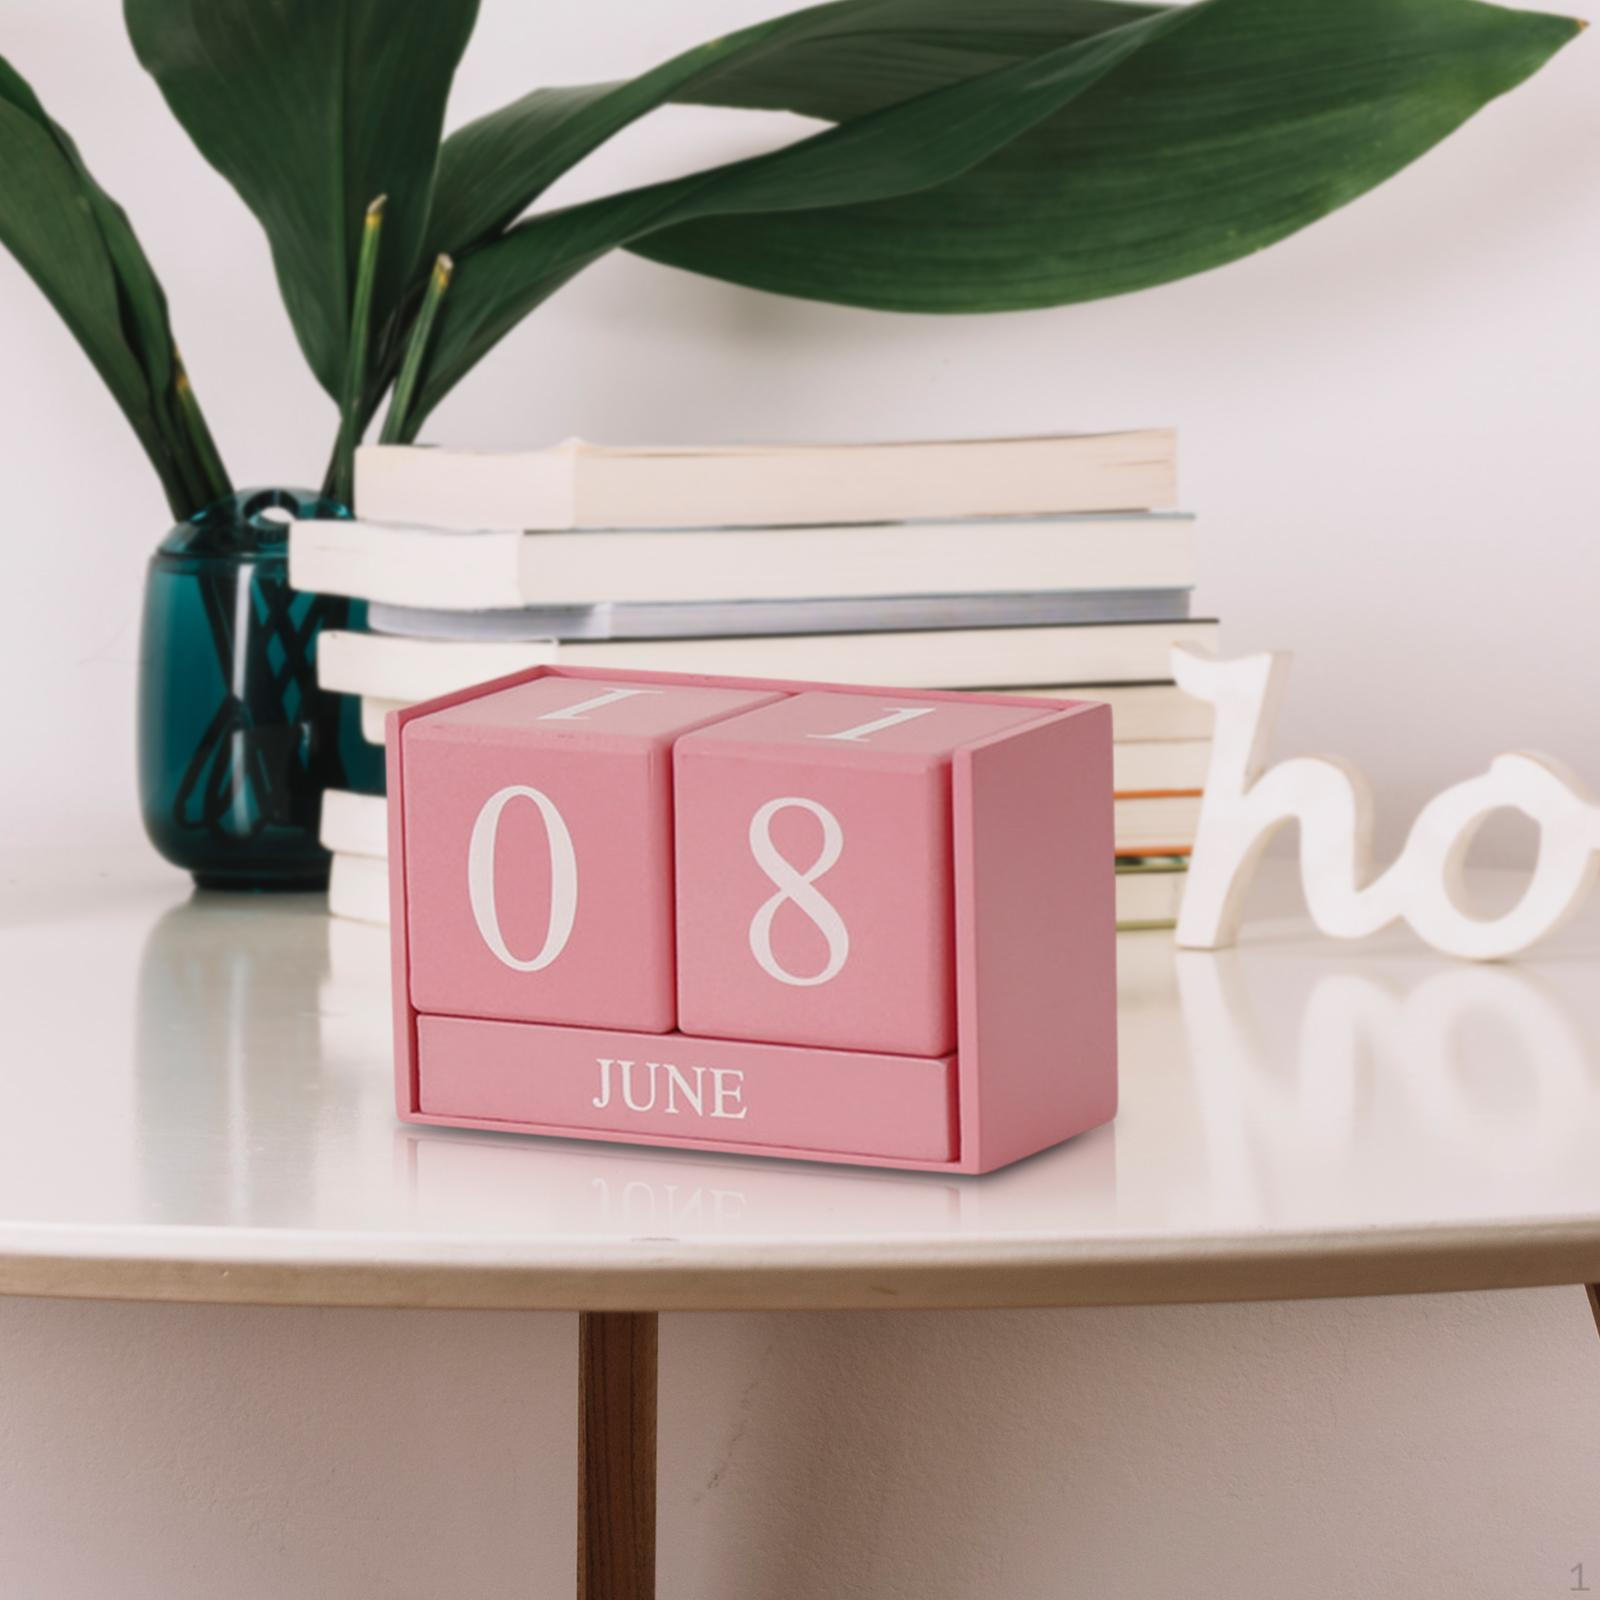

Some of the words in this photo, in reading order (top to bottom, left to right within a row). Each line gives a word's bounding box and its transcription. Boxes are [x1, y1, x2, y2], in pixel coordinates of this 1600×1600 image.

[807, 708, 936, 742] 1
[468, 785, 578, 972] 0
[749, 797, 850, 986] 8
[592, 1058, 748, 1120] JUNE
